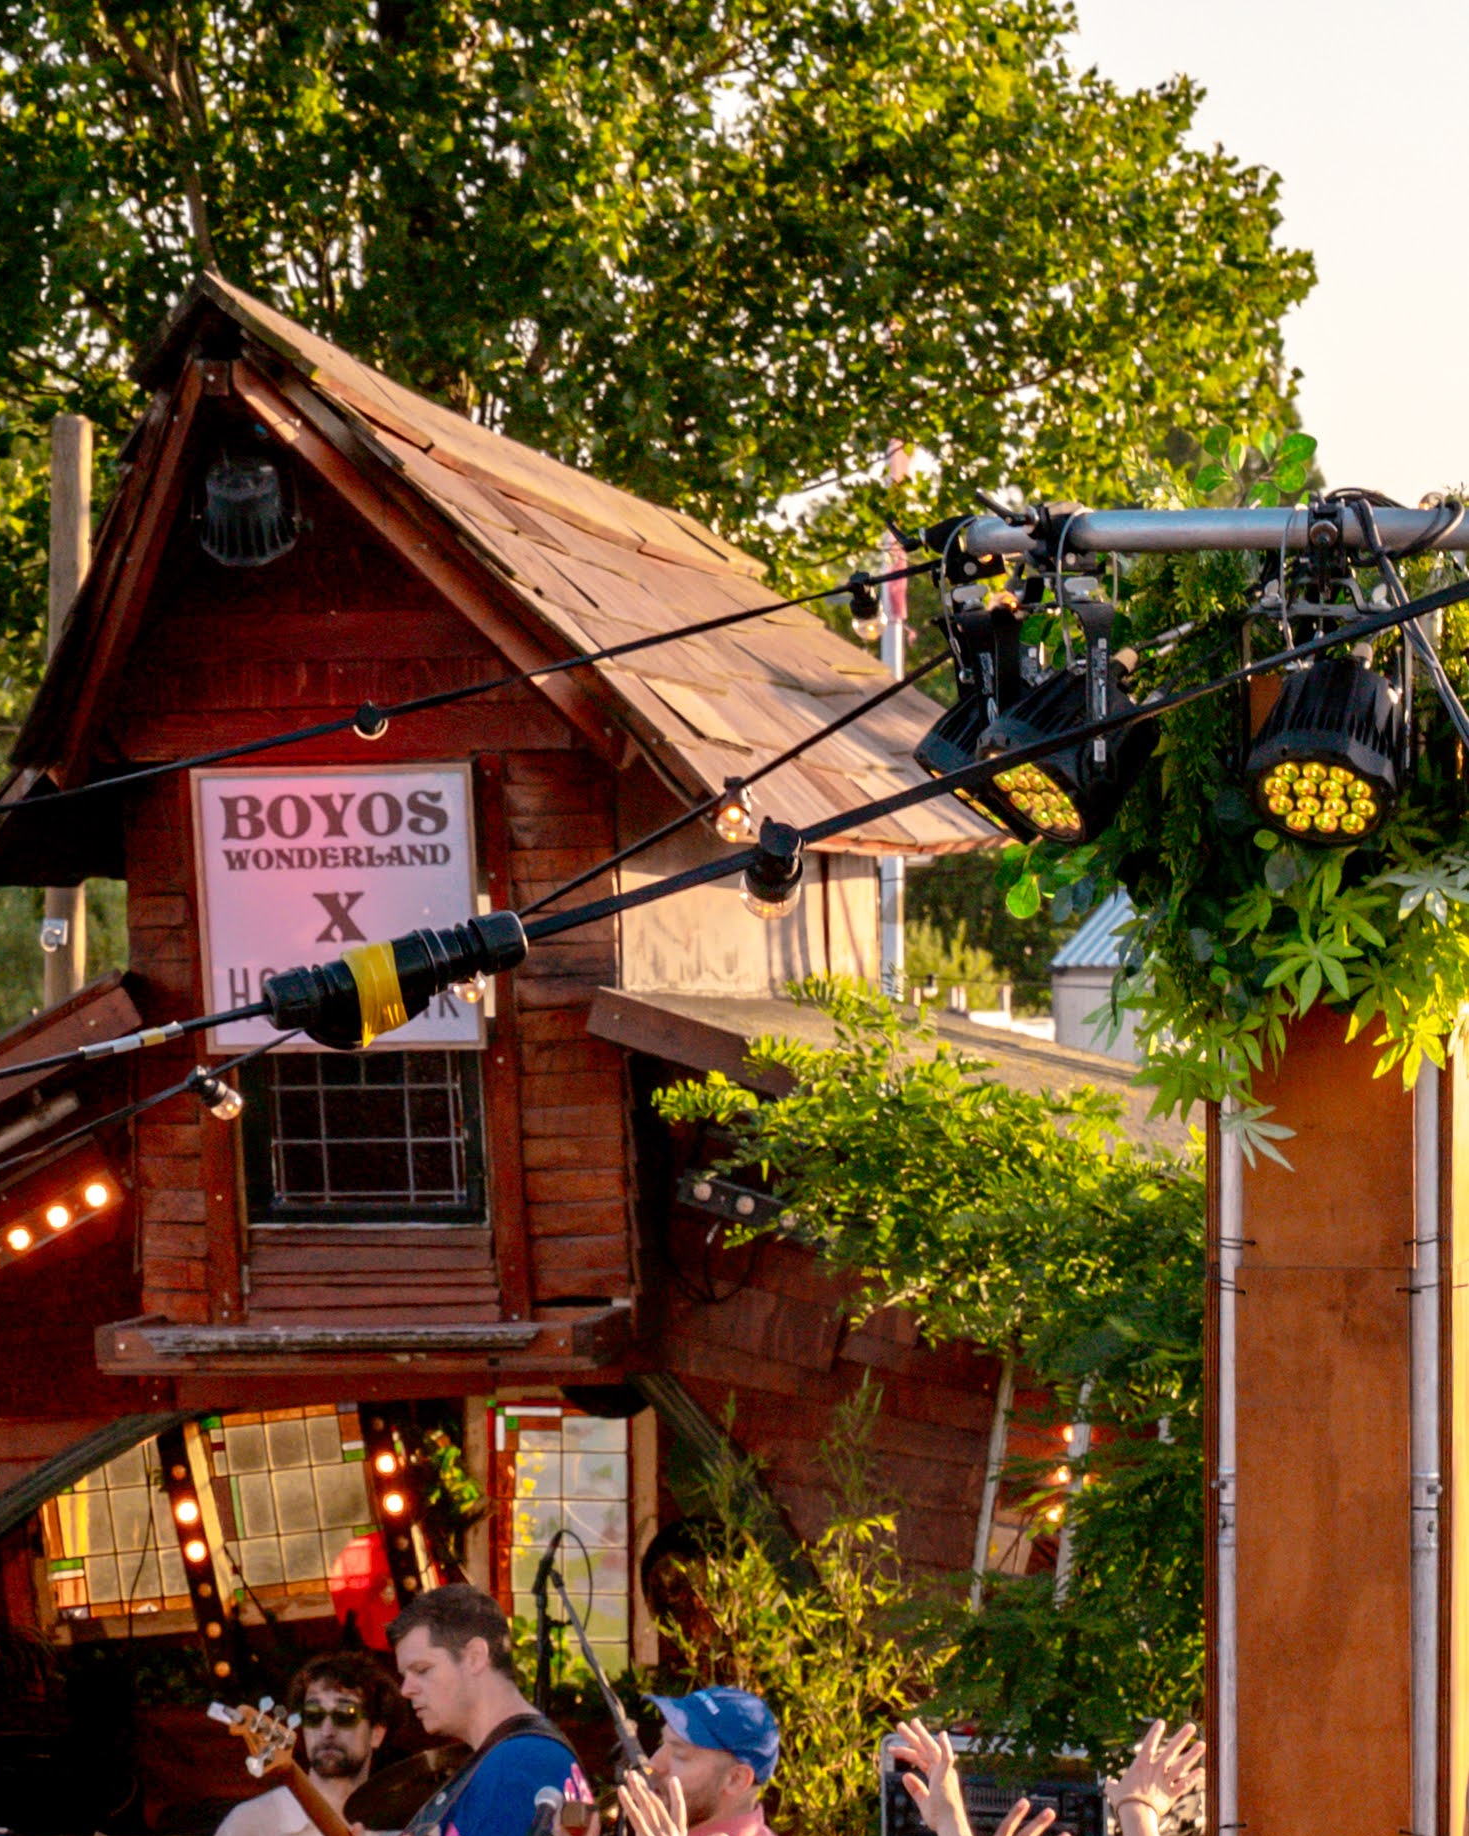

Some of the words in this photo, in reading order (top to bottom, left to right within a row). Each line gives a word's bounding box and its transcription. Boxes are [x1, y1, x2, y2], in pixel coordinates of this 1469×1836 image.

[219, 790, 449, 840] BOYOS
[223, 843, 451, 871] WONDERLAND
[312, 891, 368, 943] X
